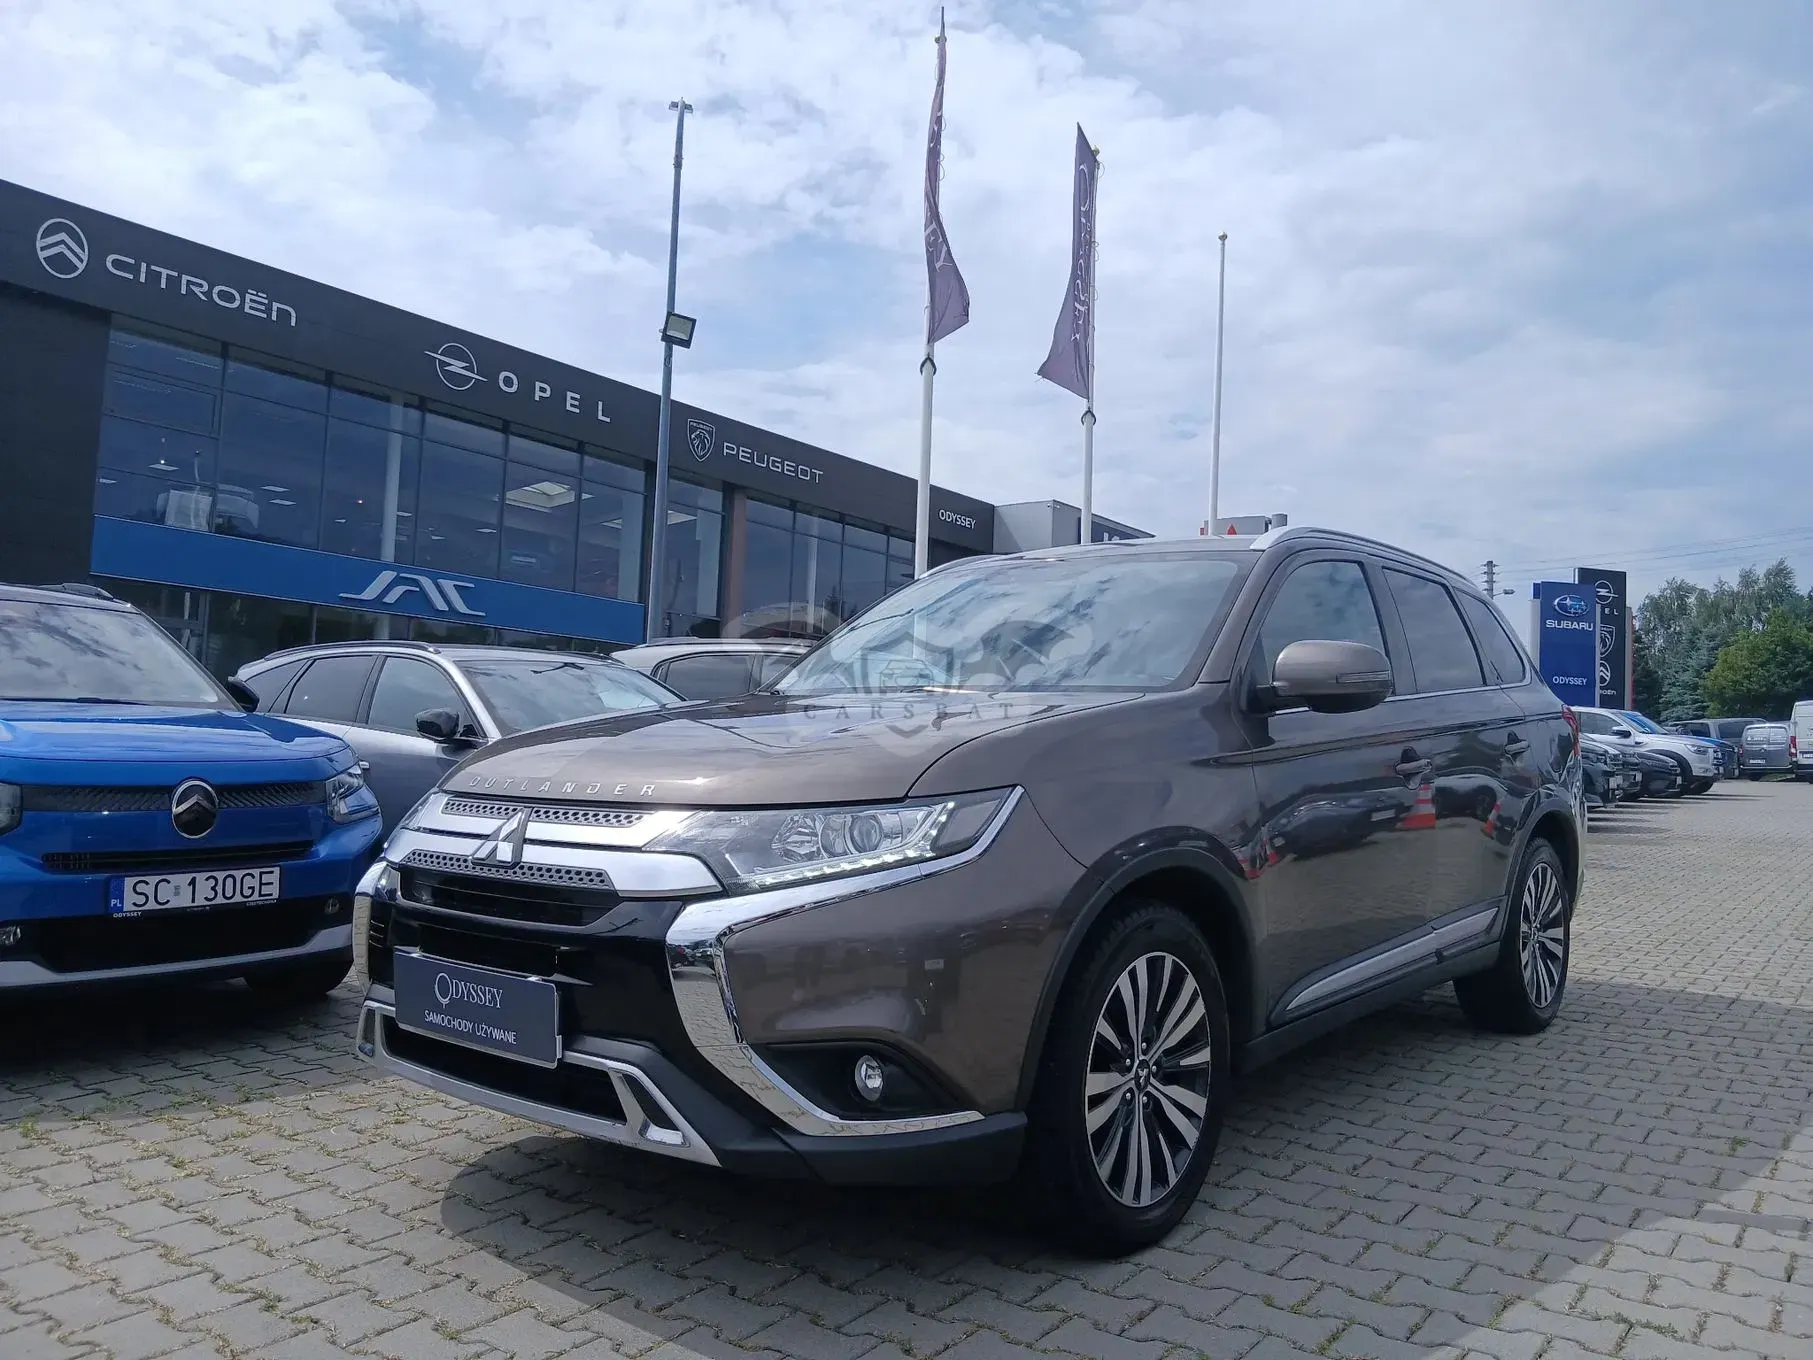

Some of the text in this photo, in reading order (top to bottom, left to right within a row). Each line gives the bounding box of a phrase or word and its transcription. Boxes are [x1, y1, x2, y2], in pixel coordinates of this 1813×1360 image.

[498, 371, 611, 423] OPEL
[723, 442, 824, 484] PEUGEOT
[939, 509, 976, 529] ODYSSEY
[337, 570, 487, 617] JAC
[1545, 619, 1594, 631] SUBARU
[1552, 675, 1588, 686] ODYSSEY
[469, 776, 656, 796] OUTLANDER
[110, 899, 123, 908] PL
[131, 870, 275, 908] SC 130GE
[434, 972, 503, 1009] ODYSSEY
[424, 1009, 518, 1045] SAMOCHODY UŻYWANE
